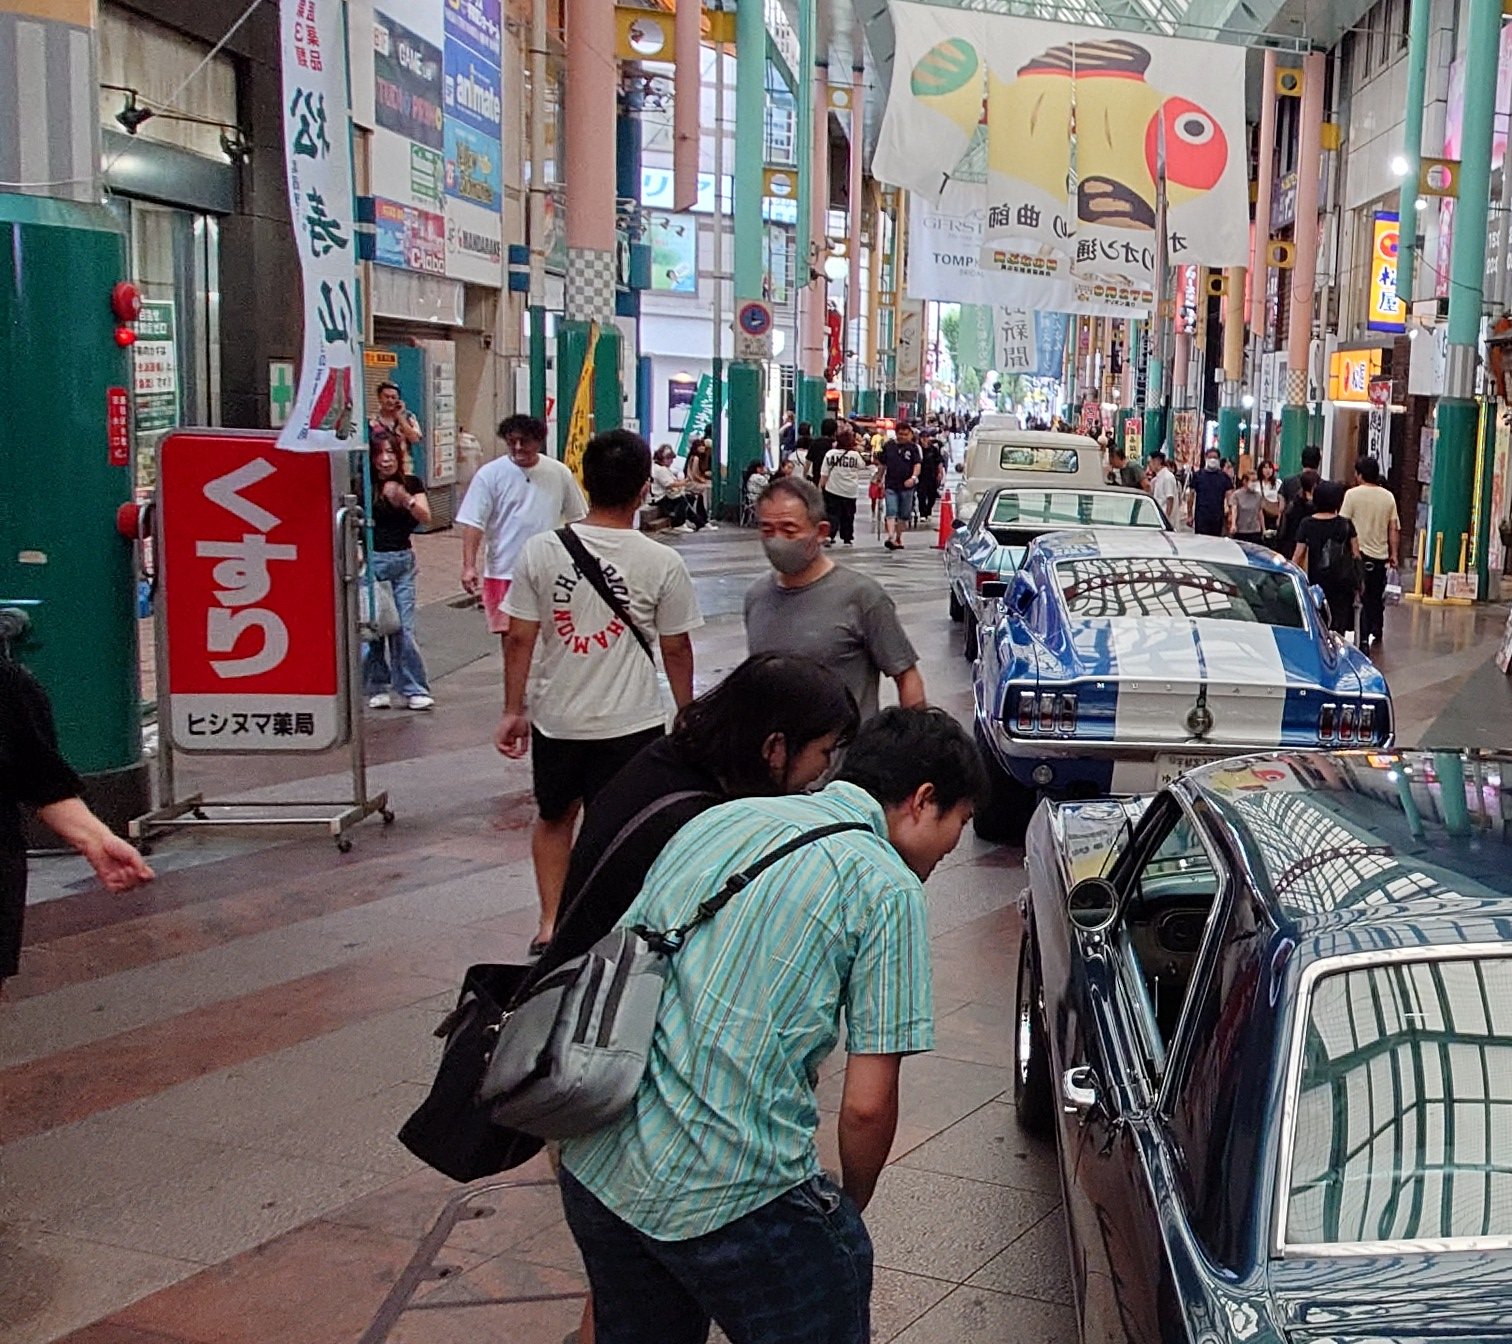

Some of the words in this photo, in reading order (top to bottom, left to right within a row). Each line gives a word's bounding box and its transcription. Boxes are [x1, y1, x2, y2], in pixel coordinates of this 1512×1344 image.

[456, 63, 500, 124] animate
[195, 457, 298, 679] くすり
[188, 712, 315, 737] ヒシヌマ薬局
